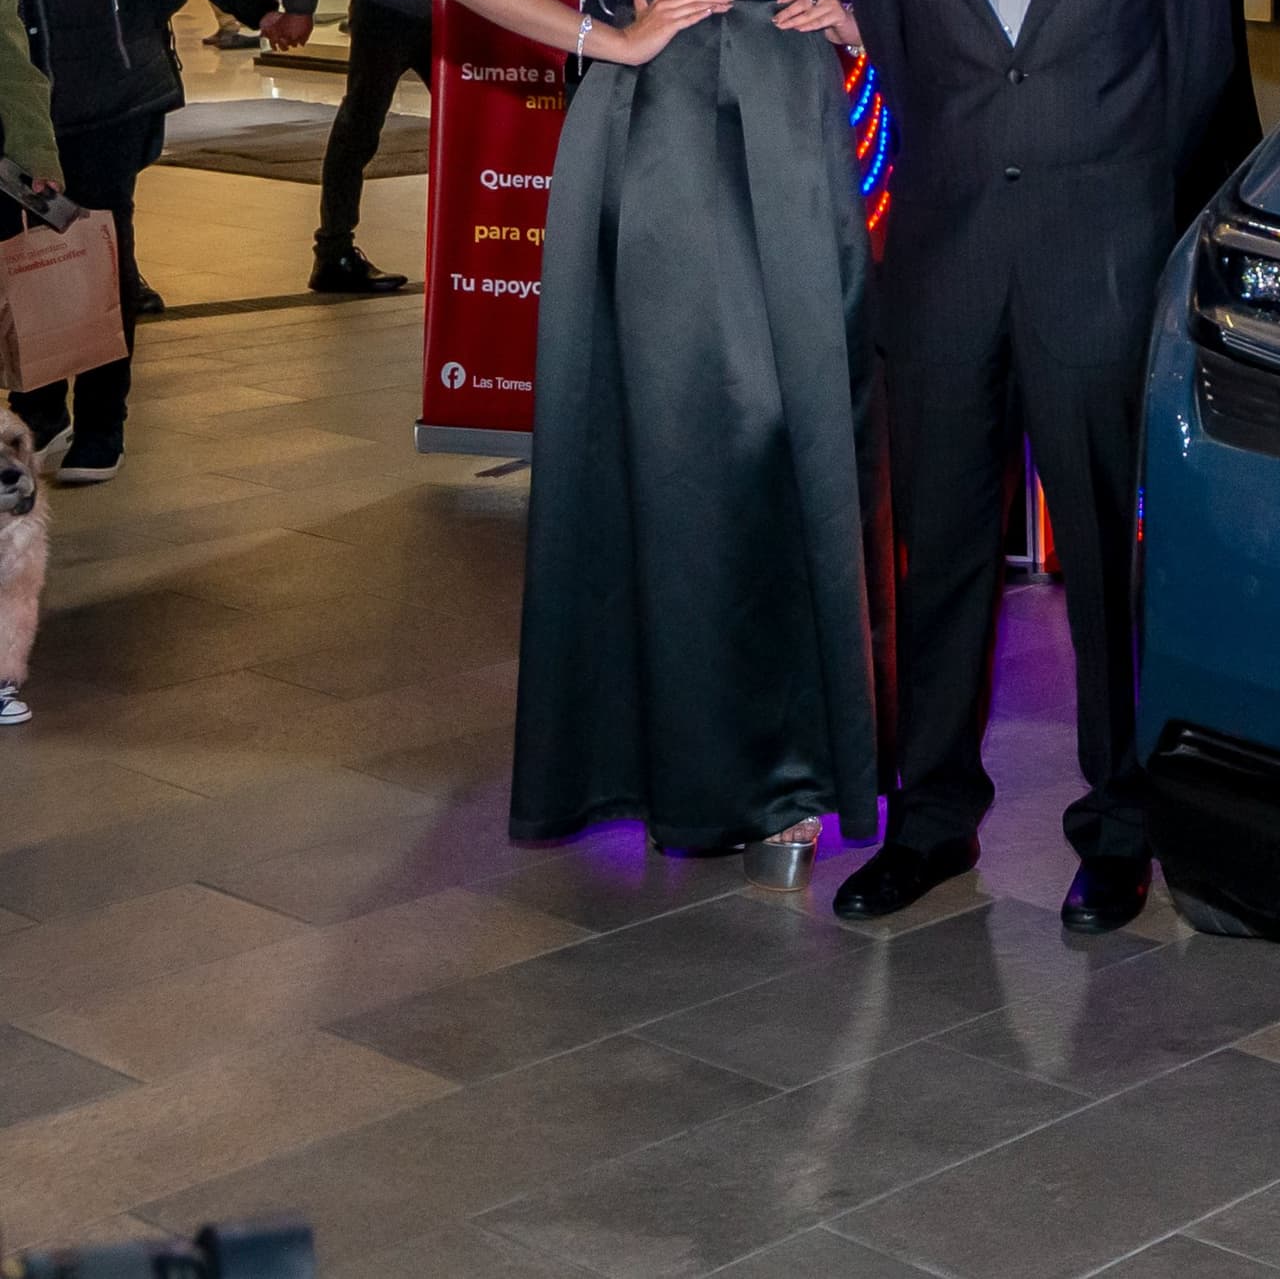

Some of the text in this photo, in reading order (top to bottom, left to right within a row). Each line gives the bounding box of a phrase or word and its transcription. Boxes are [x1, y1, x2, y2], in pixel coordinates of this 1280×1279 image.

[461, 63, 539, 82] Sumate
[544, 69, 556, 83] a
[526, 91, 565, 110] ami
[475, 224, 521, 243] para
[451, 273, 475, 292] Tu
[473, 375, 493, 389] Las
[497, 376, 533, 392] Torres
